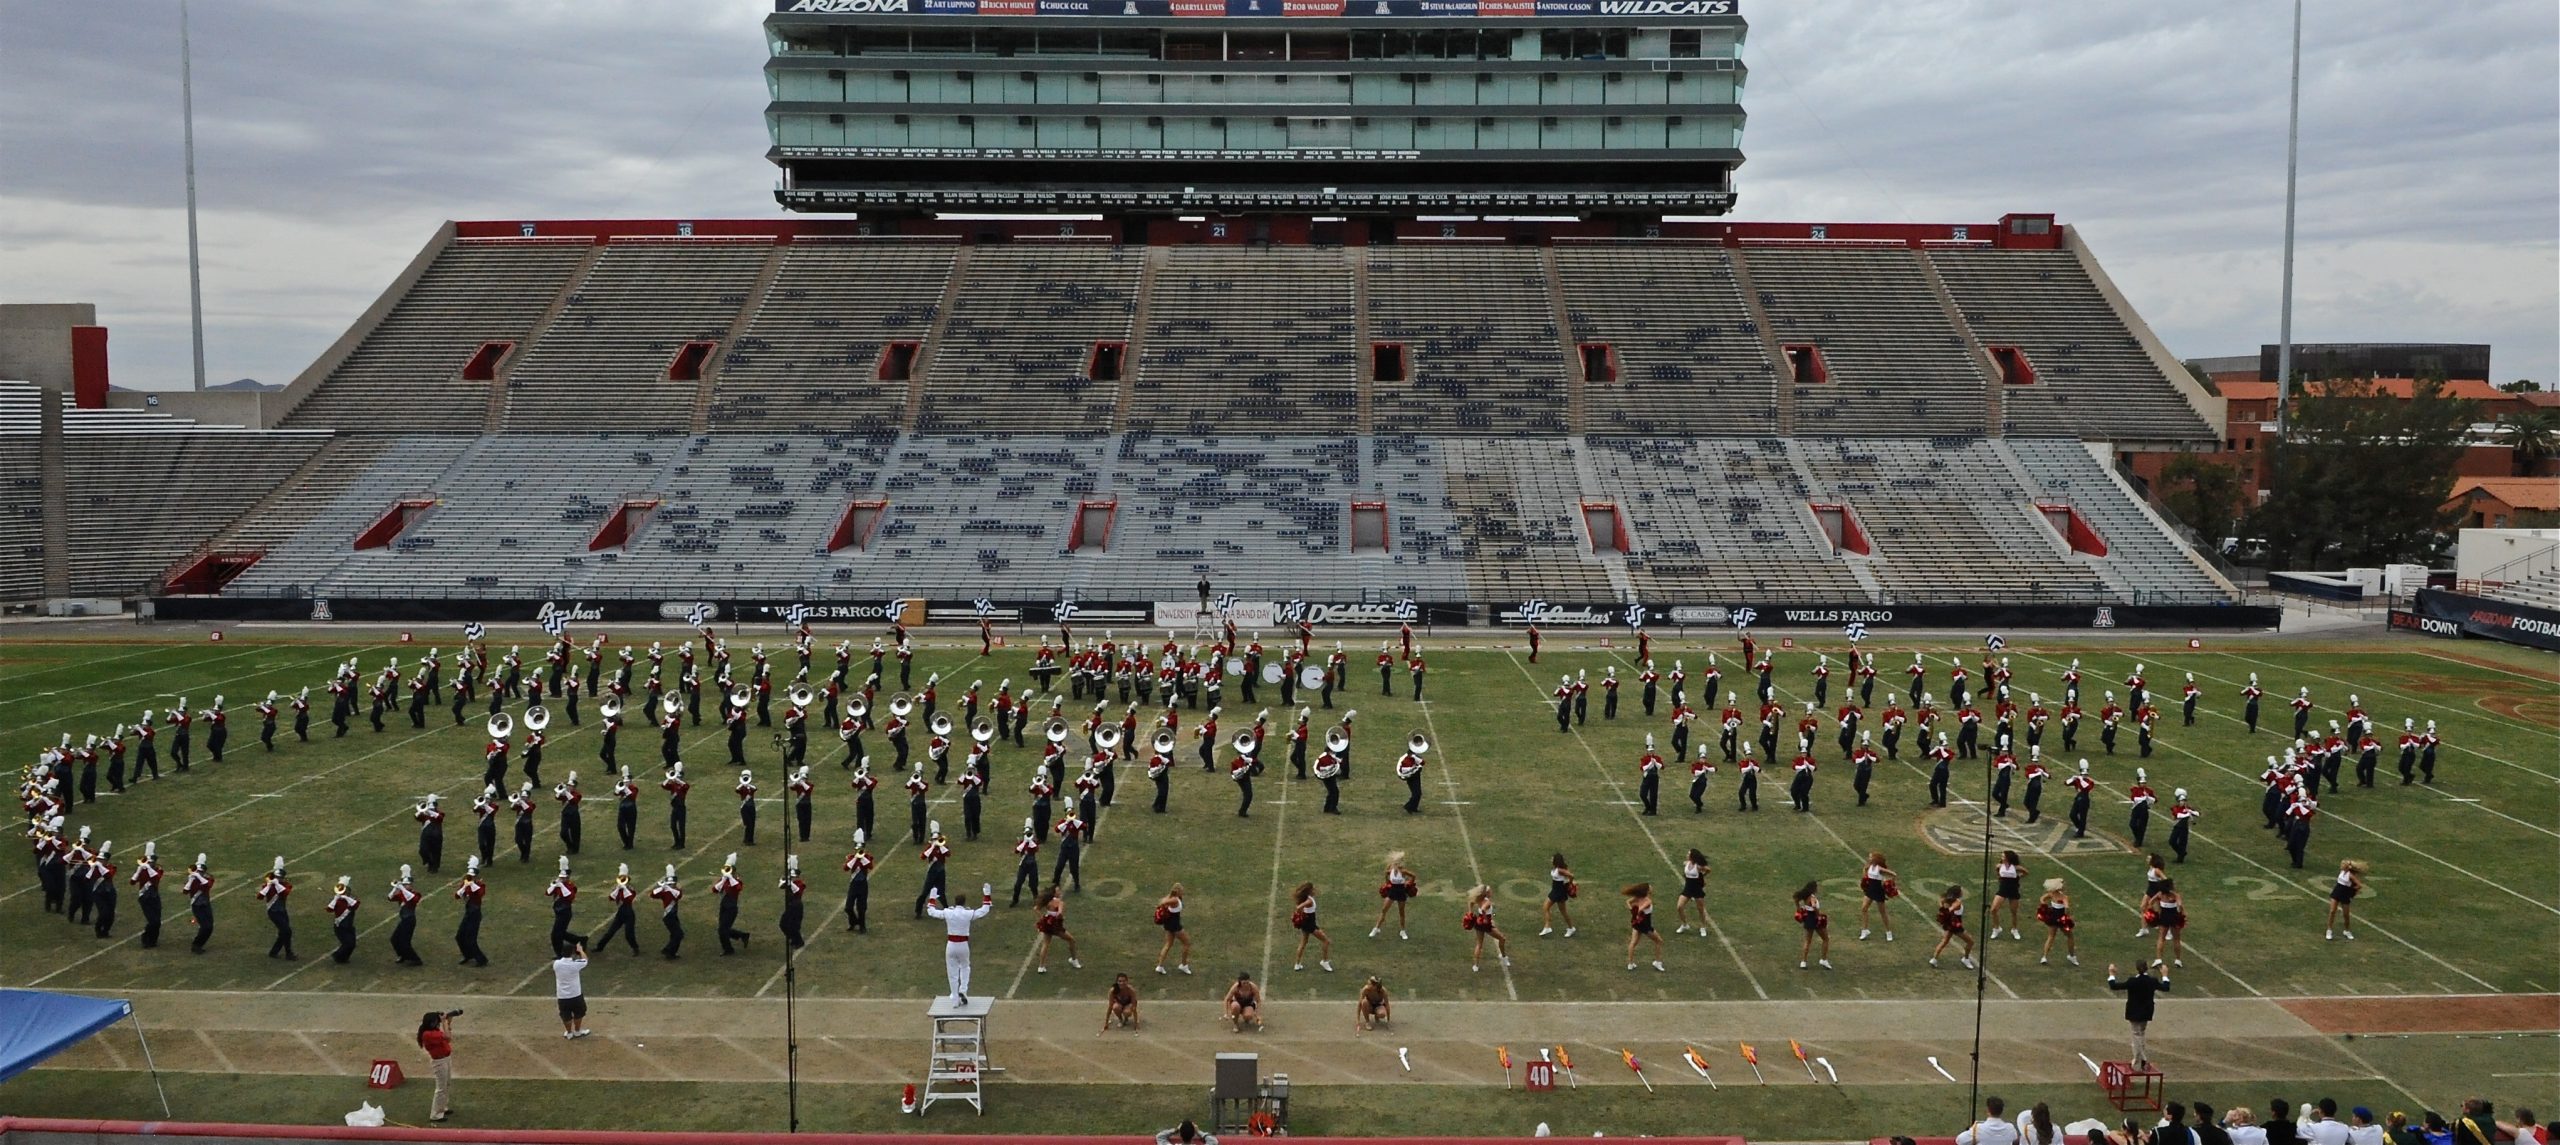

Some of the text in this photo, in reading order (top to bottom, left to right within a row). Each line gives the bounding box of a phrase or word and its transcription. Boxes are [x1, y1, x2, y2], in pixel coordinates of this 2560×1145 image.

[789, 0, 908, 12] ARIZONA
[924, 0, 933, 8] 22
[1175, 3, 1204, 11] DARRYLL
[1205, 3, 1225, 11] LEWIS
[1600, 1, 1730, 14] WILDCATS
[522, 228, 533, 236] 17
[680, 227, 690, 236] 18
[1060, 227, 1074, 236] 20
[1214, 228, 1225, 236] 21
[1443, 228, 1455, 237] 22
[1812, 231, 1825, 239] 24
[775, 606, 882, 617] WLS FARGO
[1158, 609, 1193, 619] UNIVERSITY
[1236, 610, 1255, 619] BAND
[1257, 610, 1271, 619] DAY
[1275, 604, 1389, 624] WDCATS
[1785, 611, 1892, 621] WELLS FARGO
[371, 1064, 390, 1084] 40
[958, 1066, 972, 1082] 50
[1530, 1066, 1549, 1086] 40
